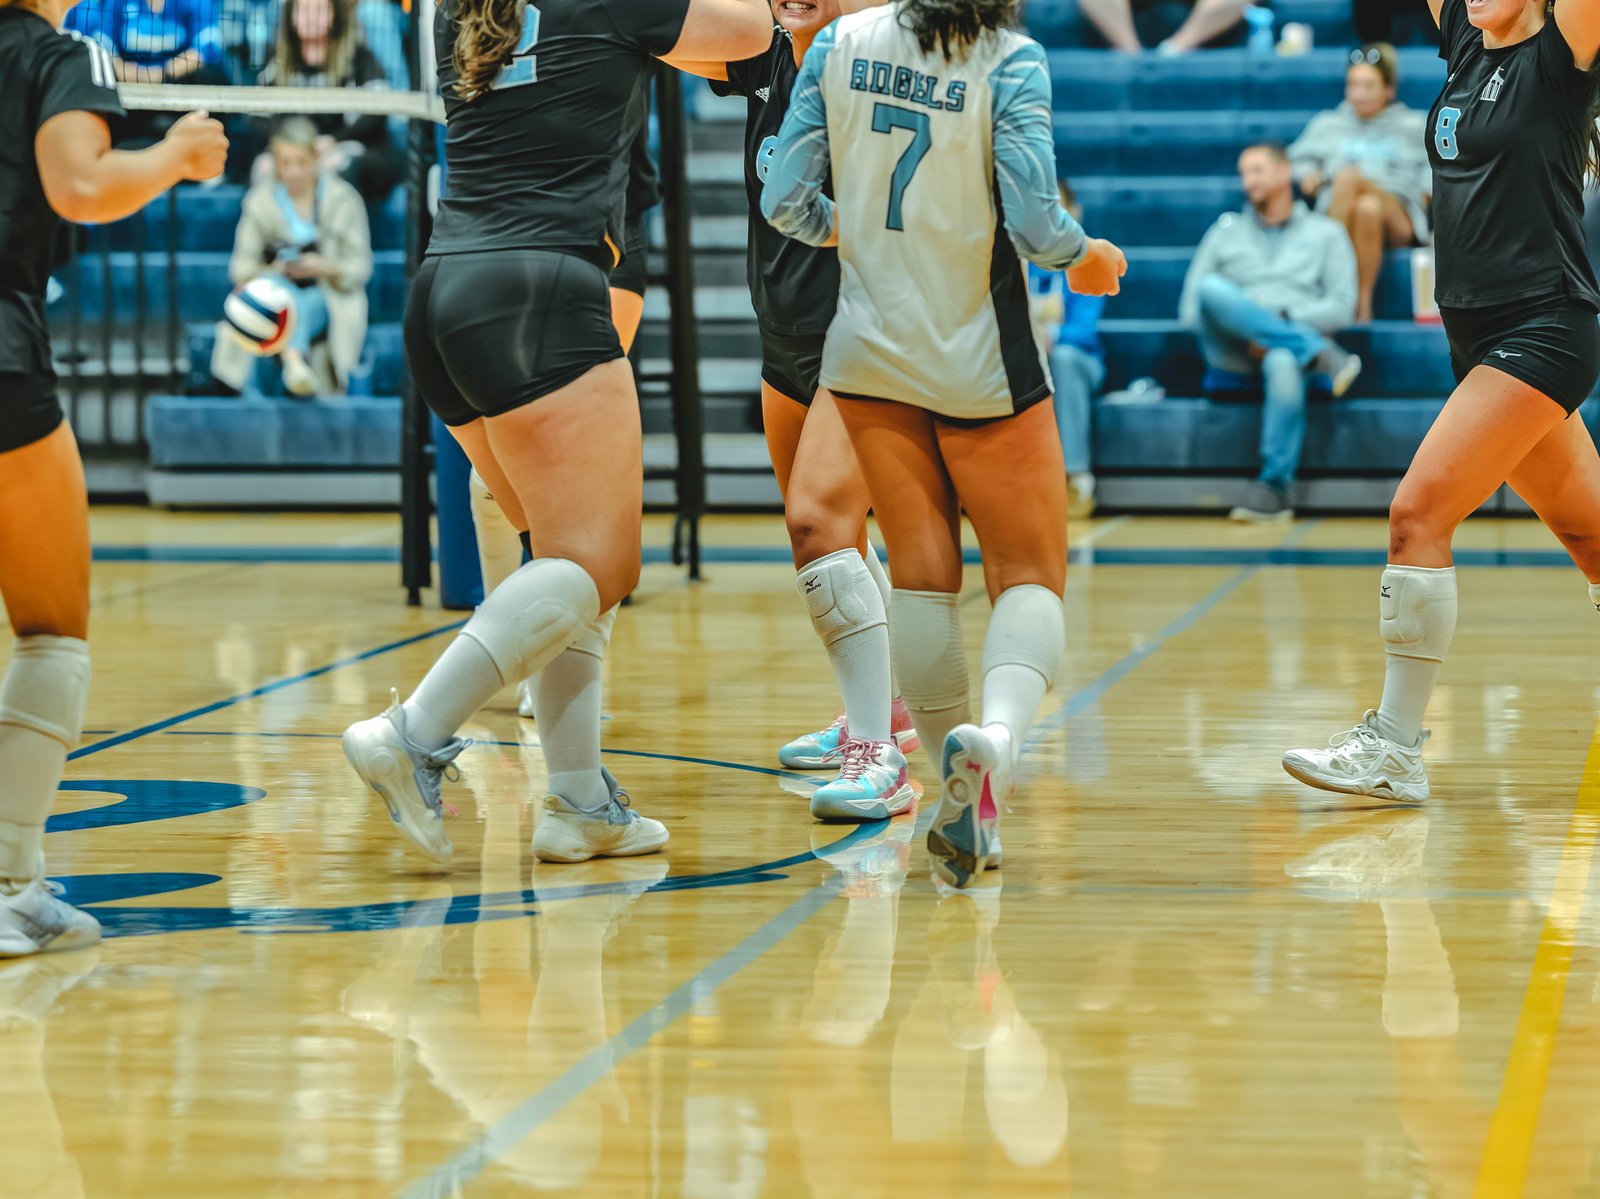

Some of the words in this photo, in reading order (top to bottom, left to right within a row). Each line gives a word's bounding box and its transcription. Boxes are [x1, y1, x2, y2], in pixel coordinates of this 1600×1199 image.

[850, 58, 966, 112] ANGELS
[1435, 106, 1461, 160] 8
[871, 101, 932, 232] 7
